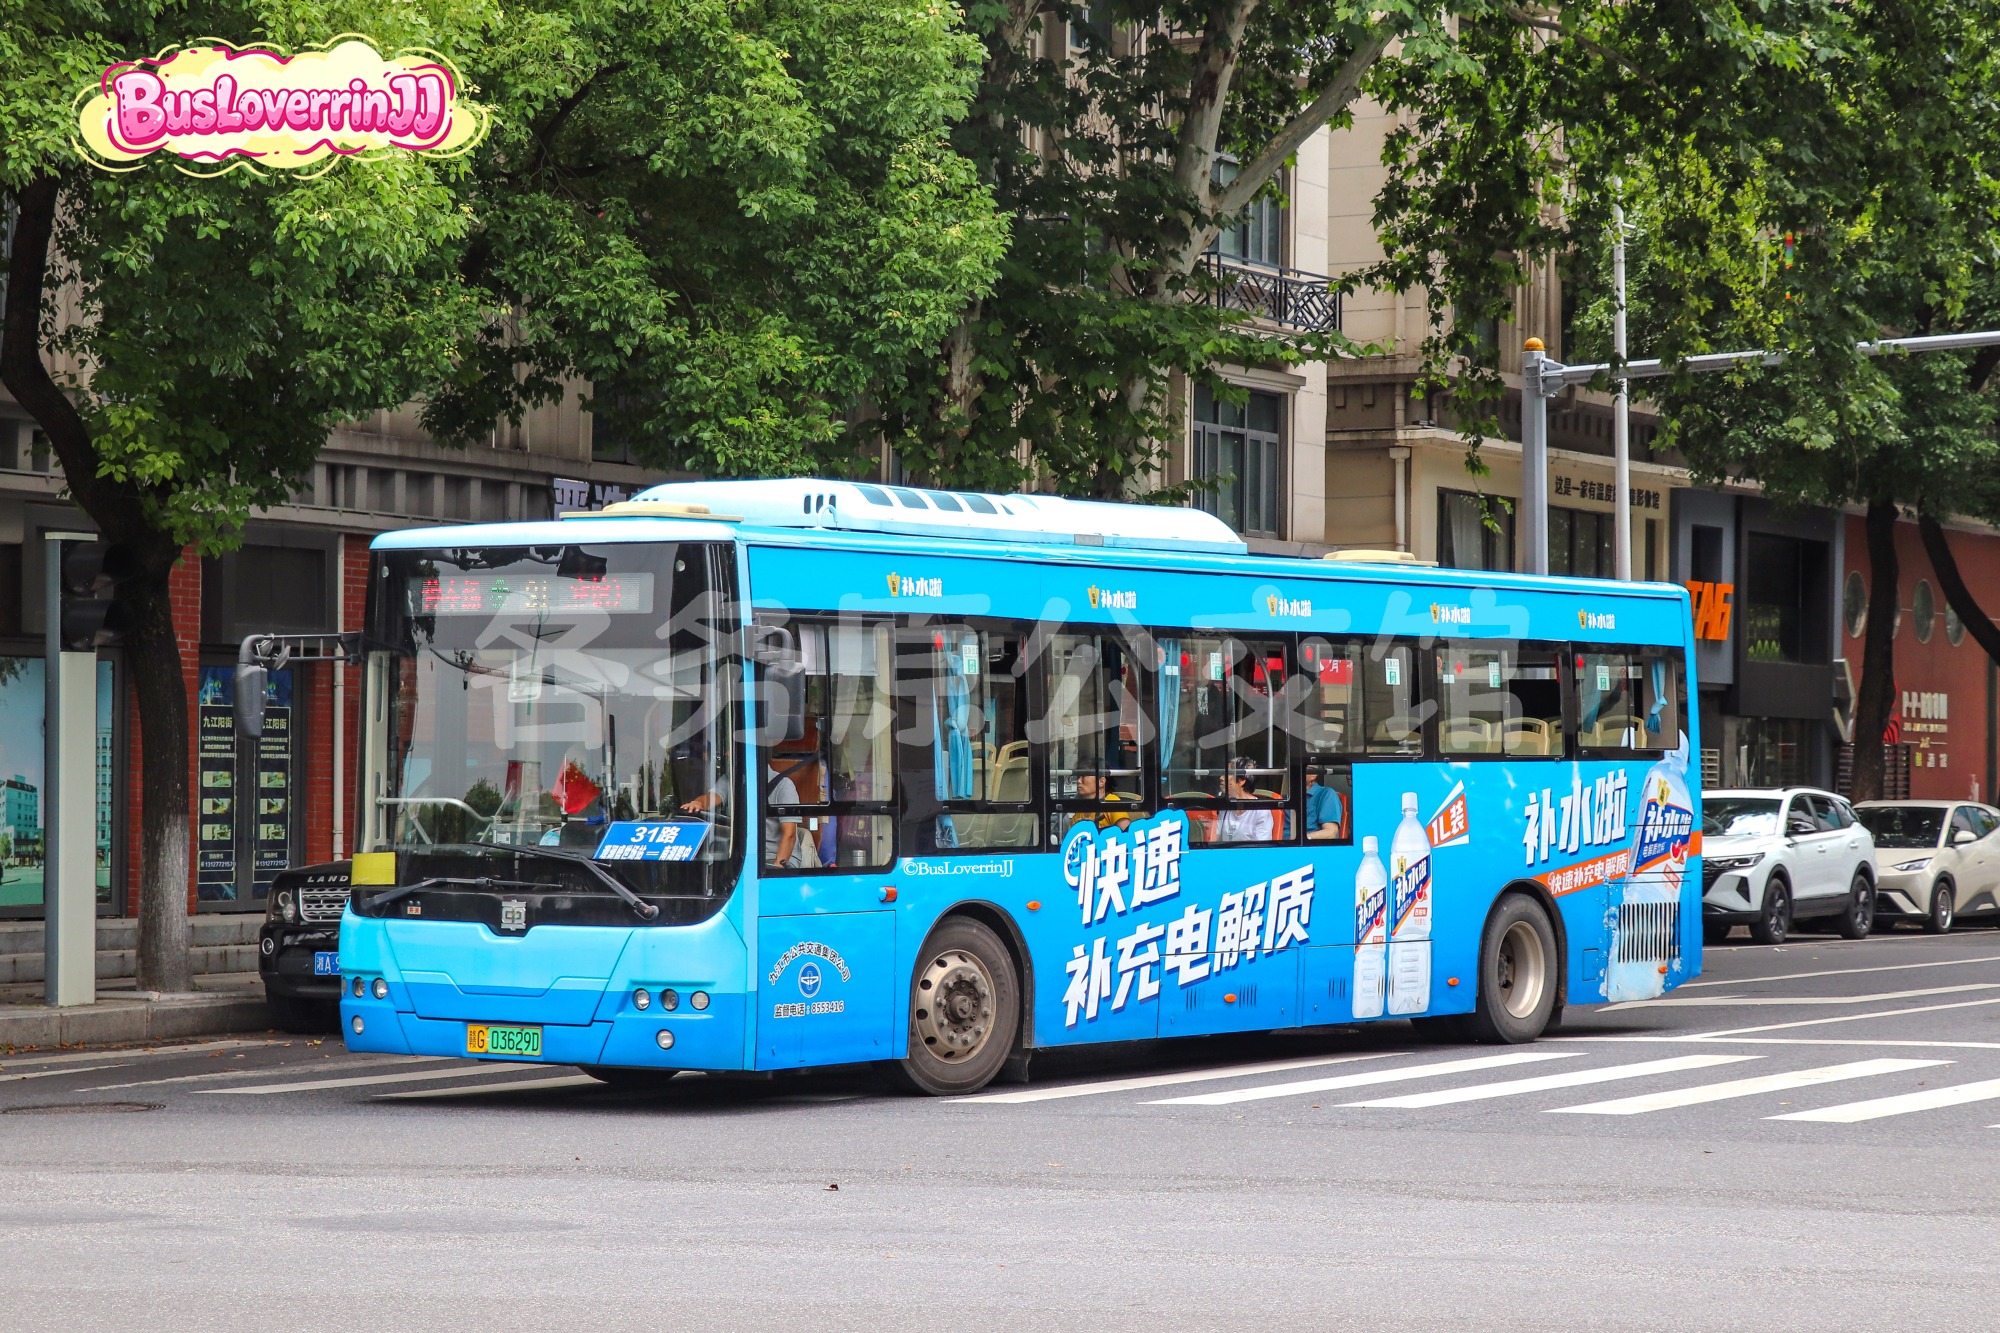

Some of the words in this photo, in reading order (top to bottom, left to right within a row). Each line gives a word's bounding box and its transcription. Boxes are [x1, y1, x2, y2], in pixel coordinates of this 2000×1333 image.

[1555, 475, 1660, 509] 这是一家有温度童影像馆
[902, 577, 942, 597] 补水啦
[1101, 590, 1137, 609] 补水啦
[1279, 599, 1311, 617] 补水啦
[1441, 606, 1471, 624] 补水啦
[1587, 613, 1616, 630] 补水啦
[1685, 580, 1734, 641] TAG
[263, 718, 287, 730] 江阳街
[630, 825, 681, 844] 31路
[1431, 799, 1465, 845] 1L装
[1523, 768, 1628, 866] 补水啦
[1644, 804, 1693, 844] 补水啦
[307, 875, 348, 883] LAND
[1076, 818, 1182, 925] 快速
[1396, 858, 1427, 909] 补水啦
[1550, 852, 1628, 895] 快速补充电解质
[1358, 889, 1384, 931] 补水啦
[768, 941, 851, 985] 九江市公共交通集团公司
[1061, 863, 1315, 1028] 补充电解质
